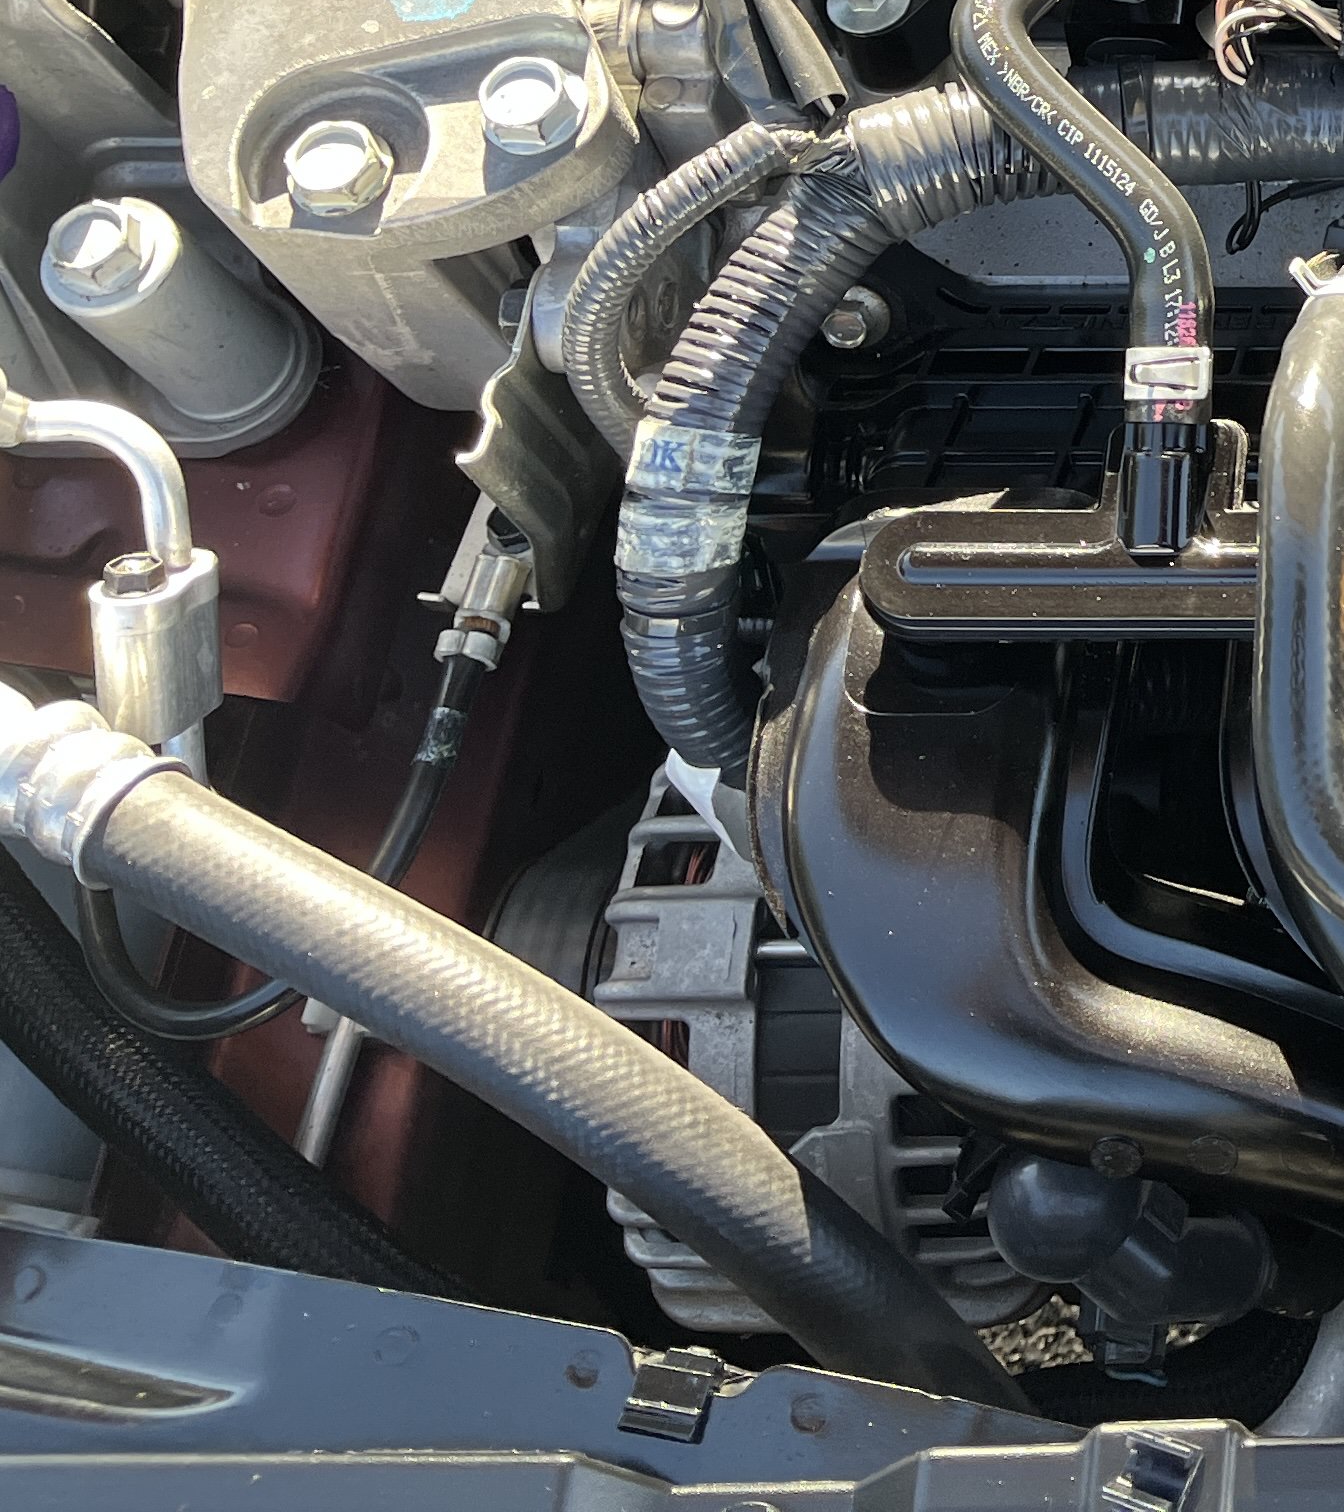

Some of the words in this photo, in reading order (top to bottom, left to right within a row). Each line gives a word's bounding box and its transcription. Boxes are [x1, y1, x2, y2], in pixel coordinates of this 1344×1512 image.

[976, 35, 1000, 67] MEX
[999, 60, 1057, 126] >NBR/CR<
[1056, 117, 1084, 148] CIP
[1082, 142, 1138, 199] 1115124
[1158, 242, 1177, 258] B
[1161, 262, 1181, 284] L3
